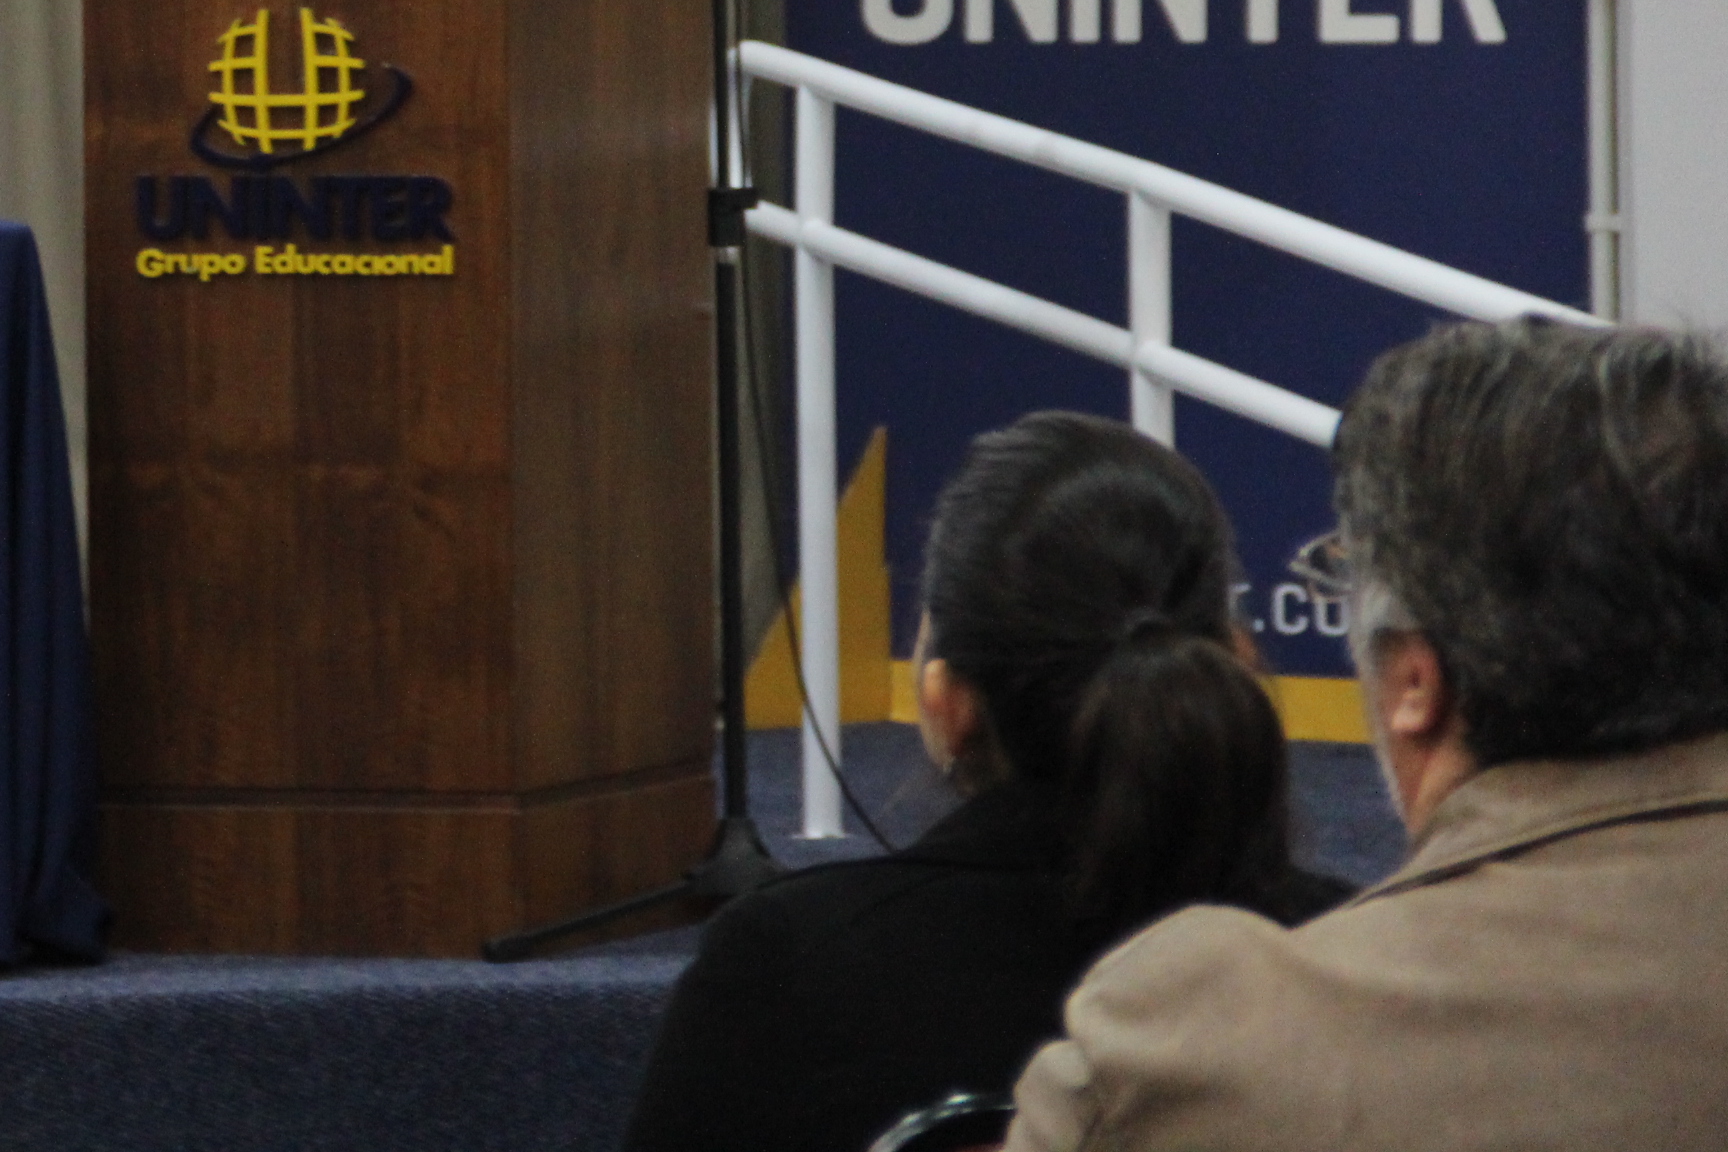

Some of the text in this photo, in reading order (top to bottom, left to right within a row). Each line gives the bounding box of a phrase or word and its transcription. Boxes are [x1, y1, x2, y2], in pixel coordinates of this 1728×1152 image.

[137, 175, 454, 242] UNINTER
[136, 243, 454, 281] Grupo Educacional
